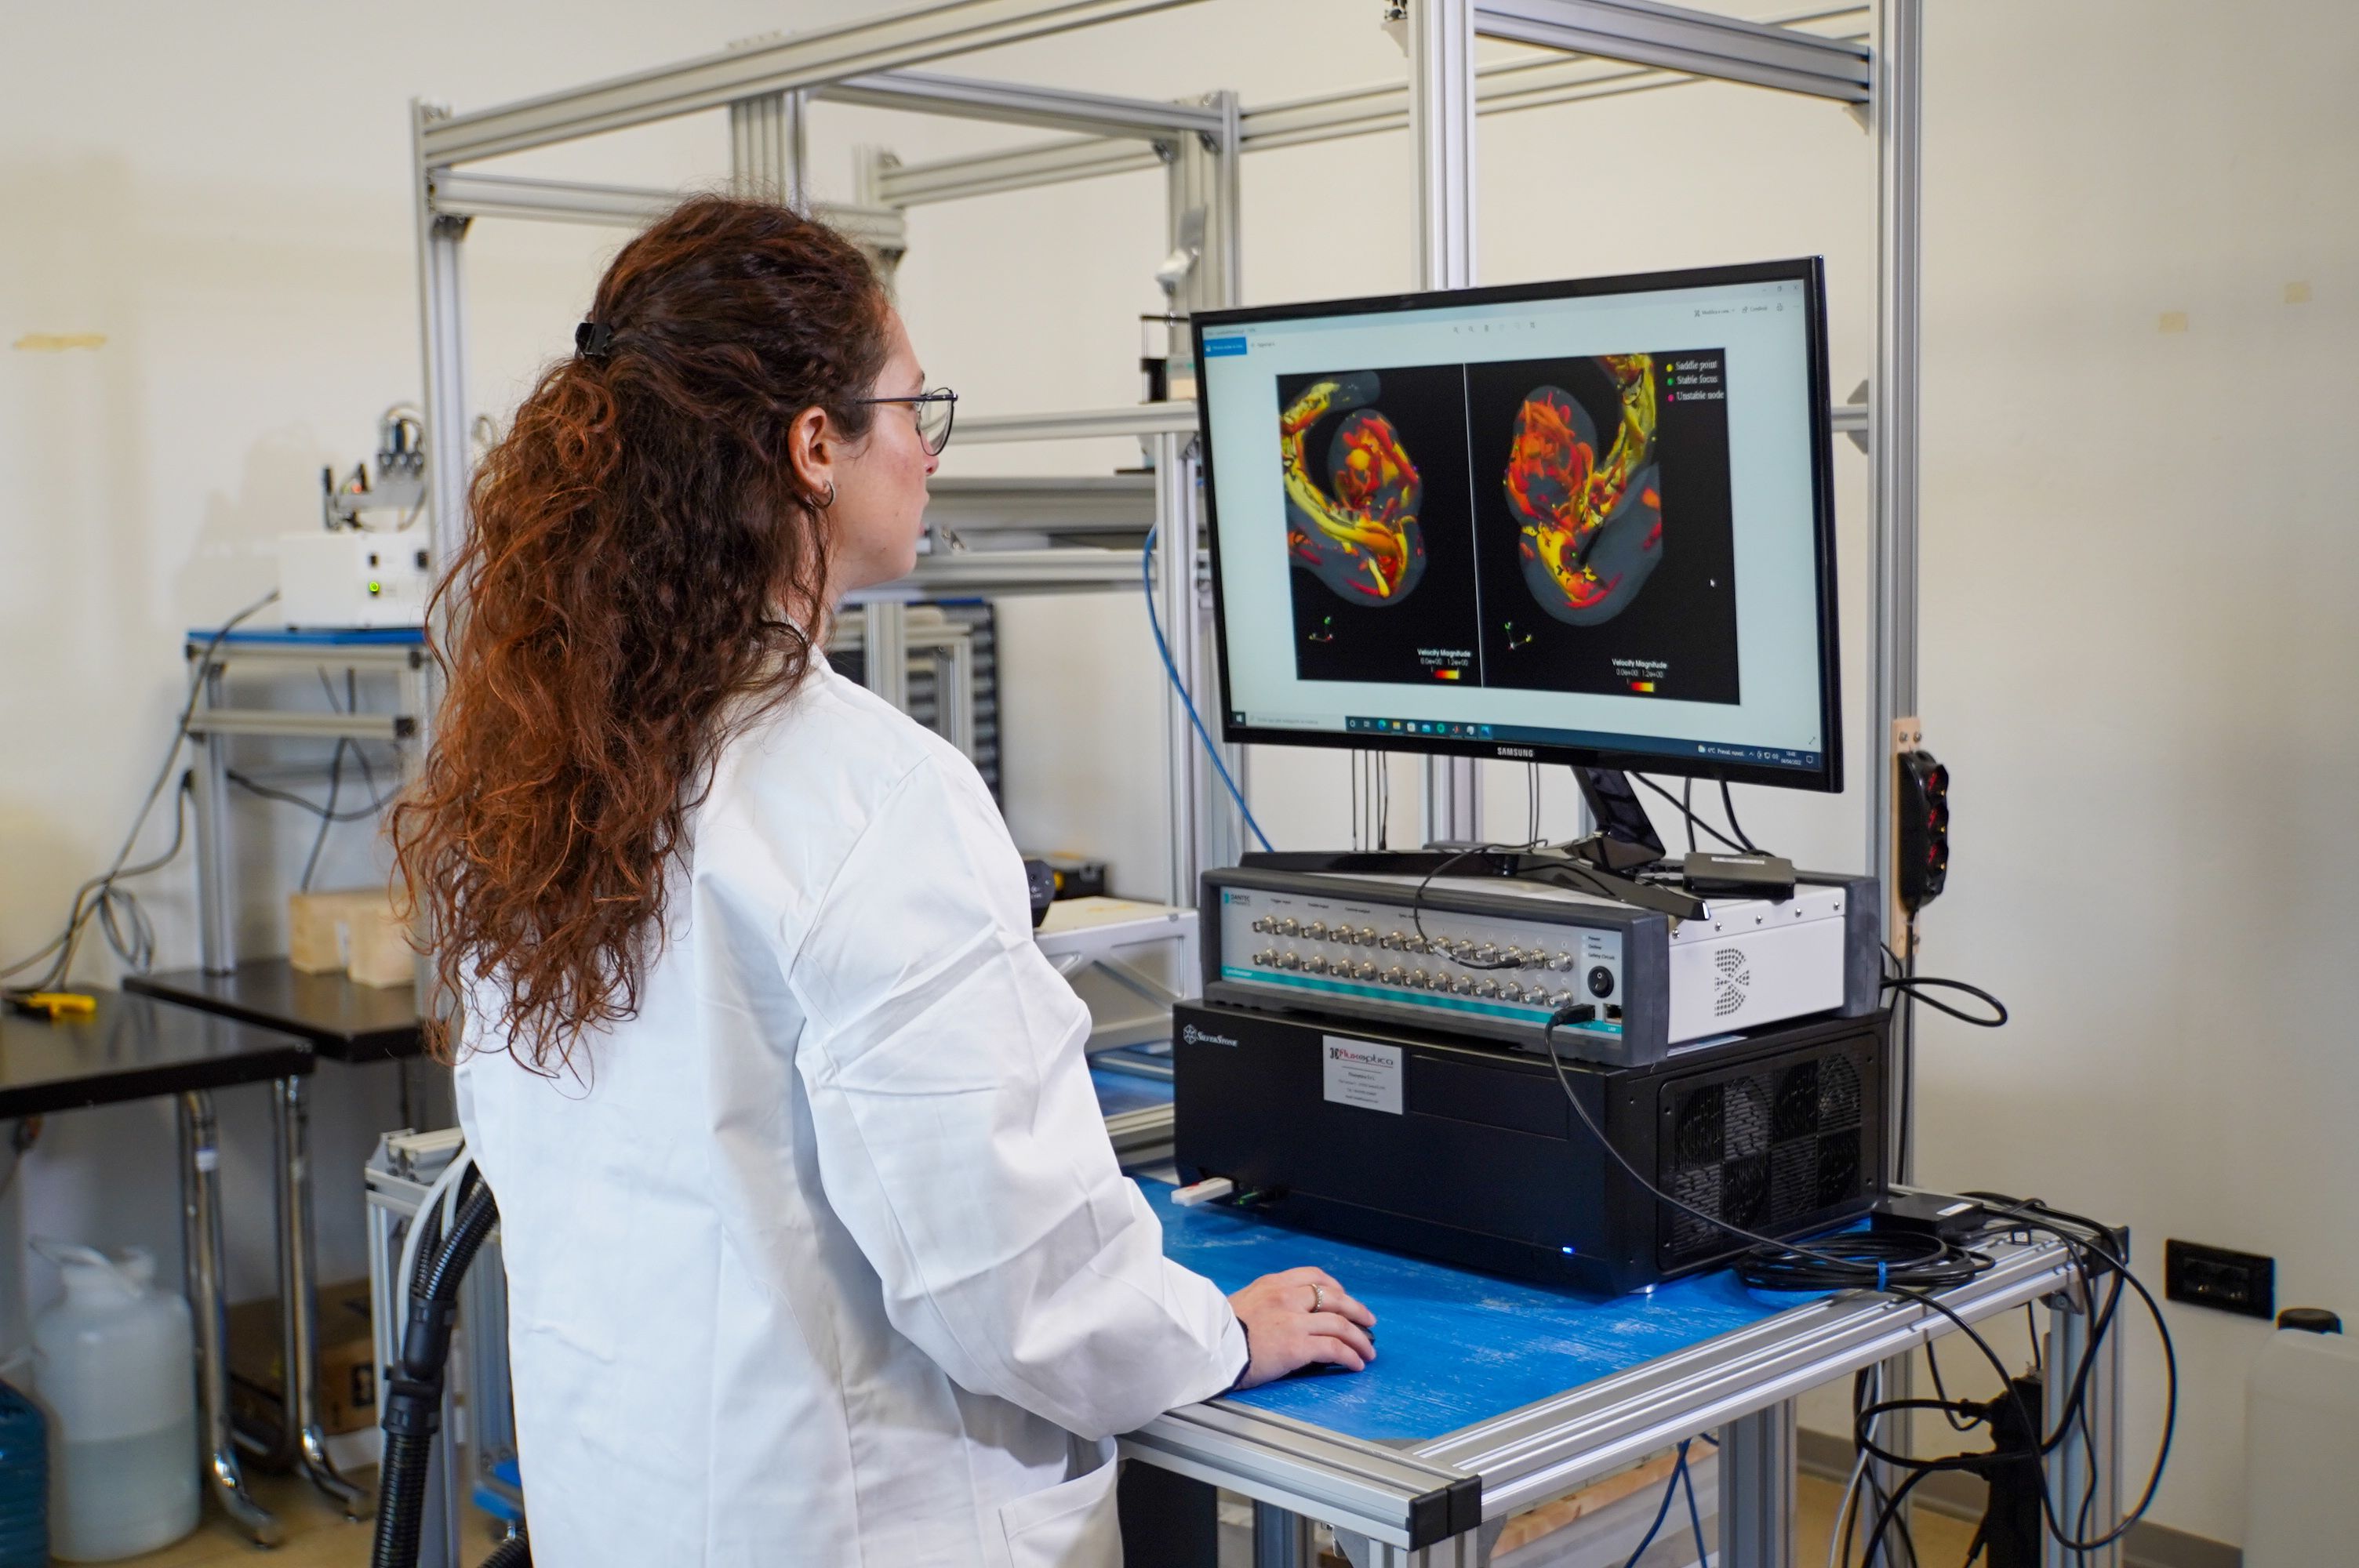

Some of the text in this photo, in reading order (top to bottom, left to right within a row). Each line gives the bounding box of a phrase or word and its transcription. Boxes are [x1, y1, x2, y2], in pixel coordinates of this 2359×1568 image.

[1676, 361, 1717, 372] Saddle point
[1677, 374, 1717, 385] Stable focus
[1677, 390, 1724, 401] Unstable node
[1417, 648, 1471, 659] Velocity Magnitude
[1612, 659, 1667, 670] Velocity Magnitude
[1497, 746, 1533, 757] SAMSUNG
[1230, 894, 1251, 902] DANTEC
